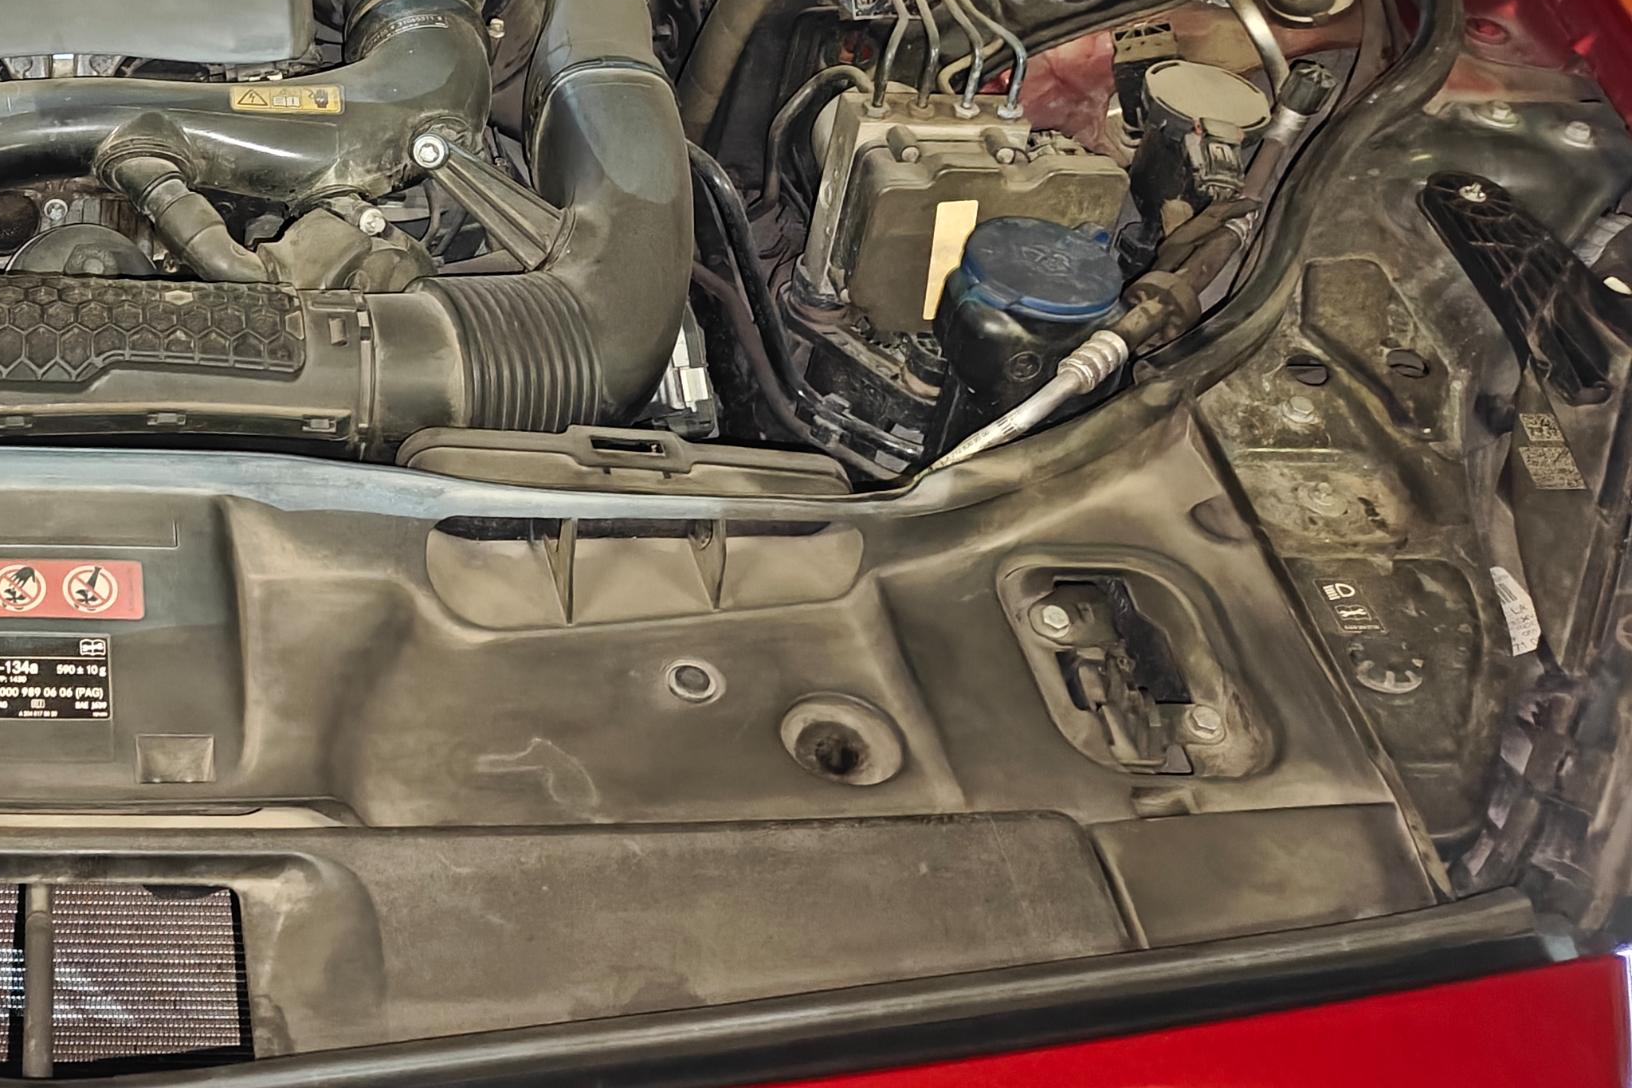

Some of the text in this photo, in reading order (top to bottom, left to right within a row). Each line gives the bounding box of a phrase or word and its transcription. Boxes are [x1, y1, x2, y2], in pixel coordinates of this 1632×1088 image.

[56, 664, 76, 675] 590
[86, 664, 98, 675] 10
[99, 666, 107, 677] g
[0, 686, 19, 697] 000
[21, 686, 41, 697] 989
[43, 686, 57, 697] 06
[59, 686, 73, 697] 06
[75, 687, 103, 700] (PAG)
